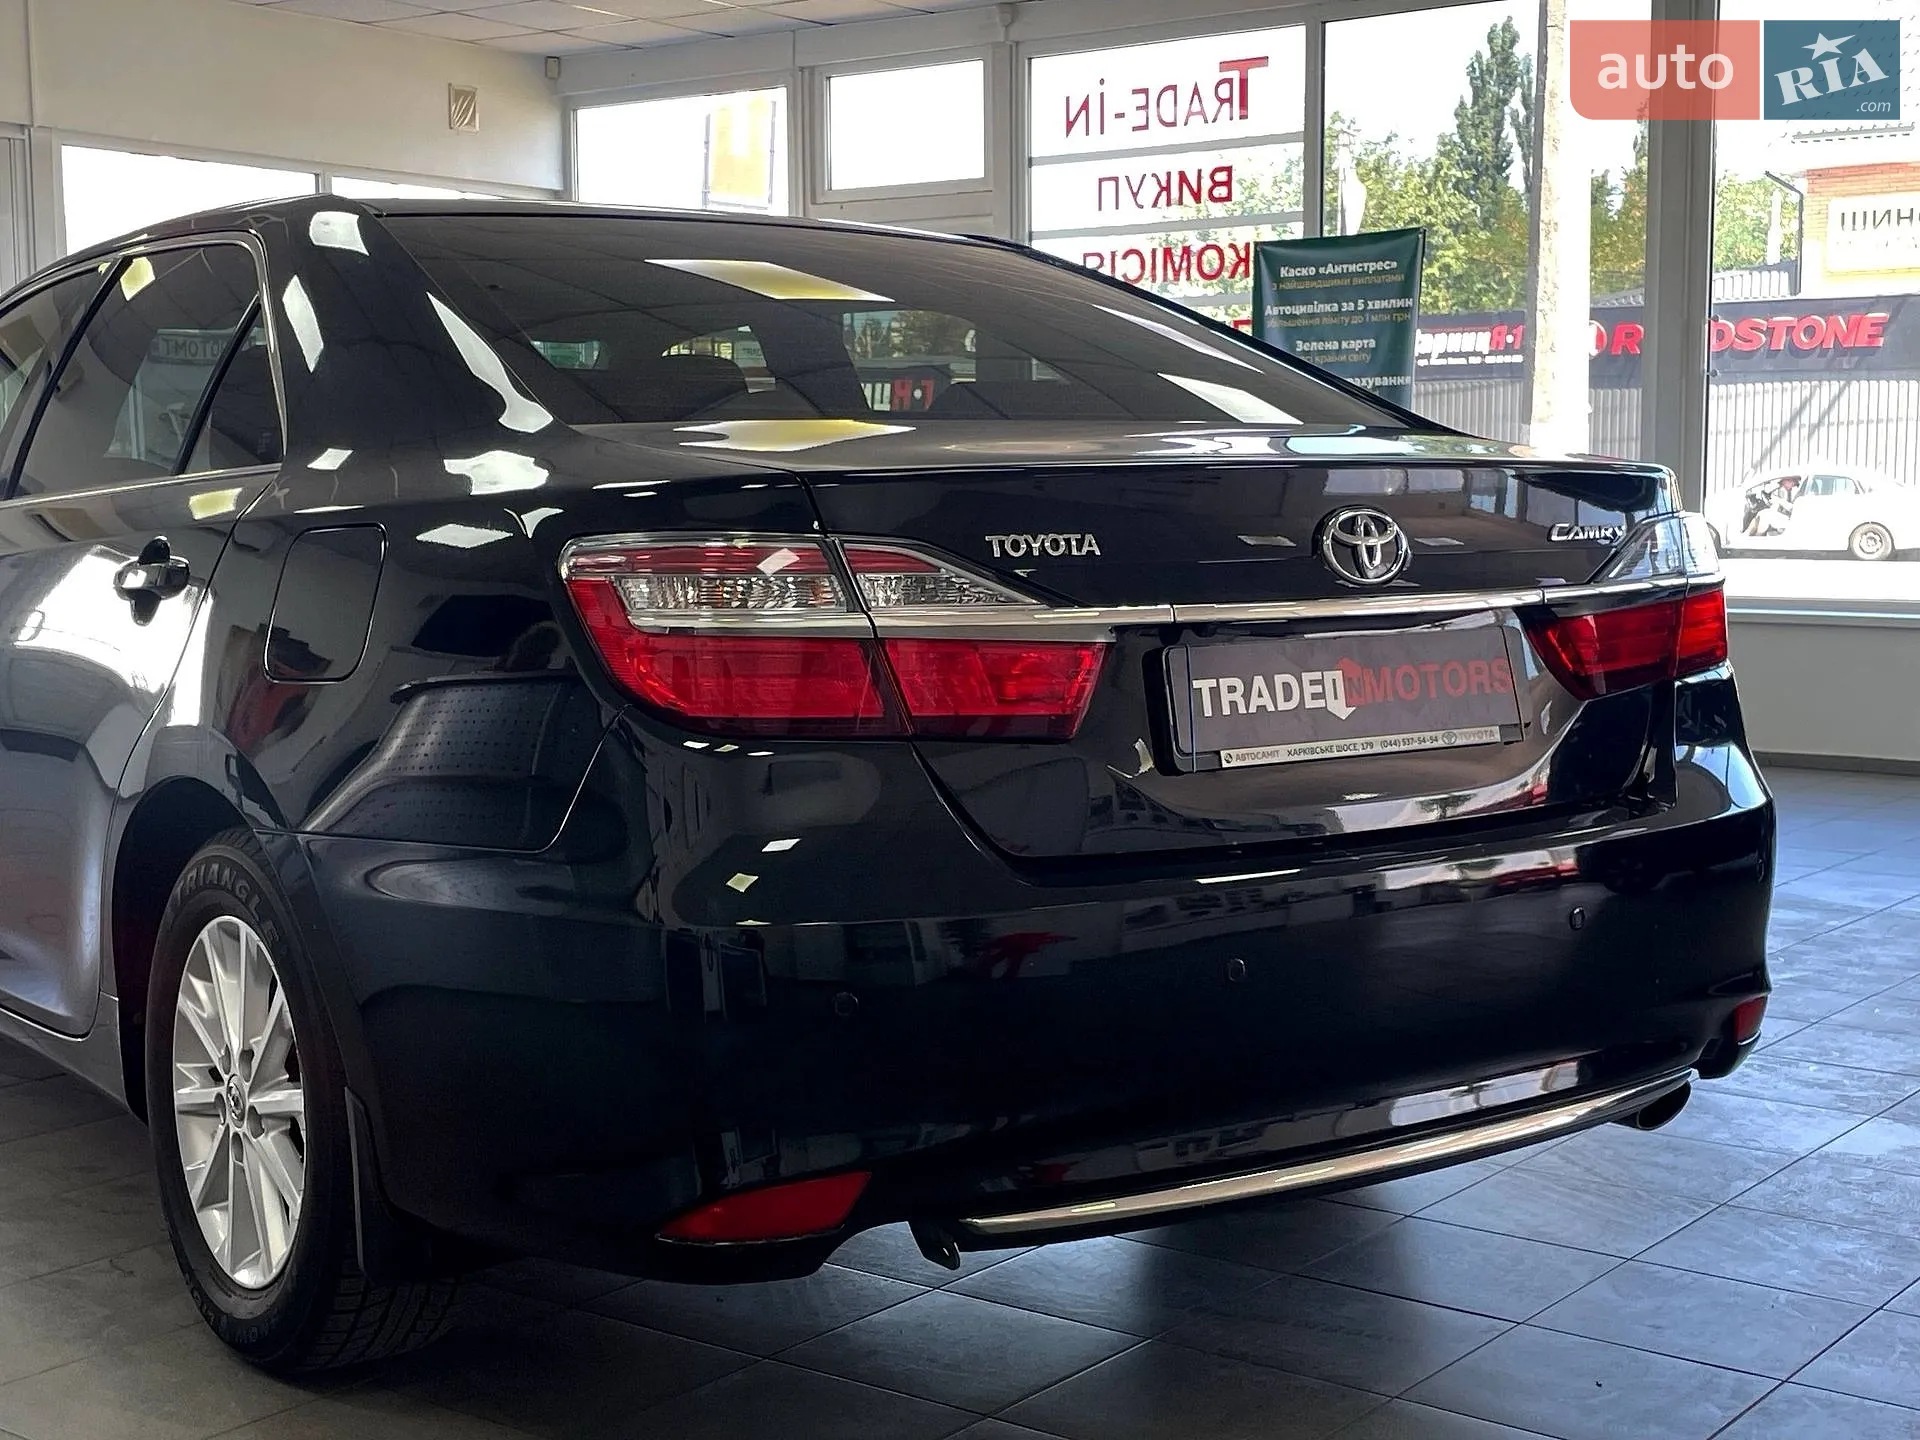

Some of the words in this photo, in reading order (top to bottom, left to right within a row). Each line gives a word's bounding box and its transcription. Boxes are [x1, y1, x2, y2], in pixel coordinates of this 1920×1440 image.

[1280, 265, 1316, 278] Каско
[1318, 259, 1398, 275] «Антистрес»
[1265, 301, 1340, 317] Автоцивілка
[1341, 301, 1355, 312] за
[1357, 299, 1365, 311] 5
[1366, 297, 1413, 311] хвилин
[1295, 339, 1340, 352] Зелена
[1340, 338, 1376, 353] карта
[985, 533, 1101, 558] TOYOTA
[1192, 671, 1325, 718] TRADE
[1363, 657, 1512, 705] MOTORS
[1286, 743, 1335, 758] ХАРКІВСЬКЕ
[1360, 741, 1374, 751] 179
[1457, 728, 1496, 742] TOYOTA
